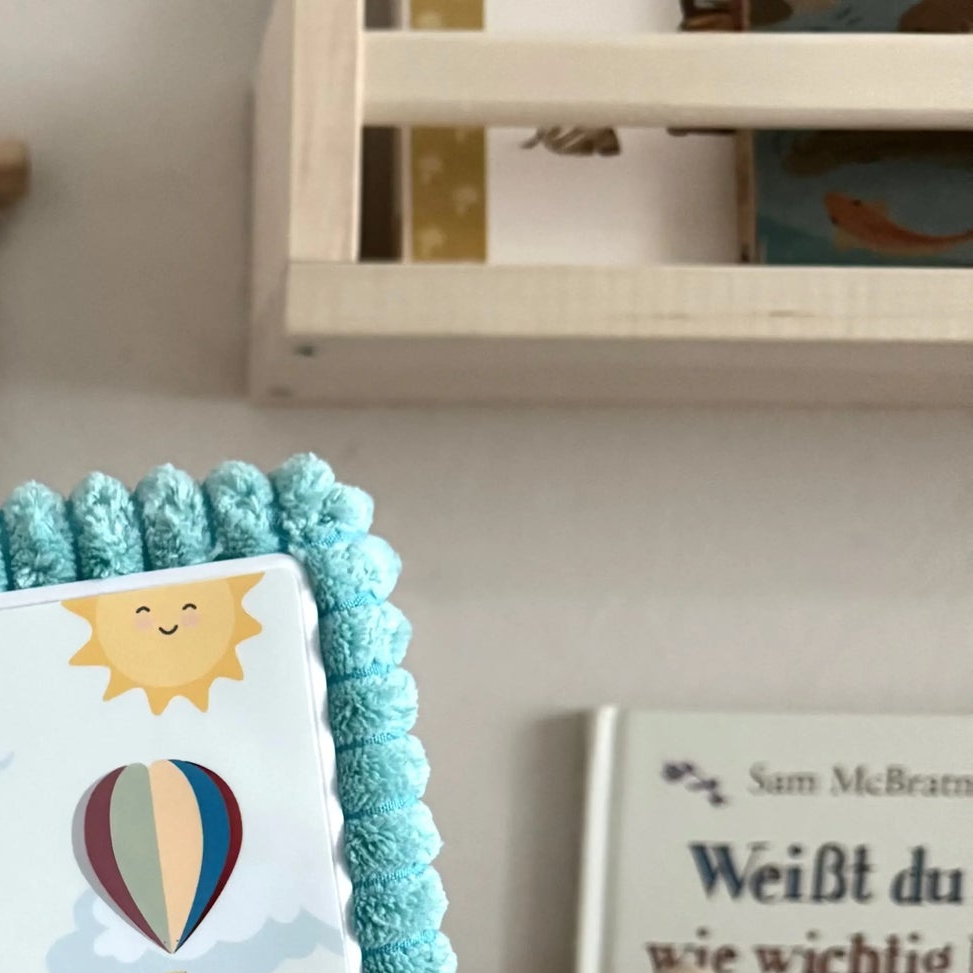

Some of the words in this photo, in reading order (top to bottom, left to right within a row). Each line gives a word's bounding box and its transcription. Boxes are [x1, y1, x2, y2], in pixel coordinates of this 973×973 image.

[749, 761, 816, 796] Sam
[688, 841, 875, 903] Weißt
[889, 845, 963, 905] du
